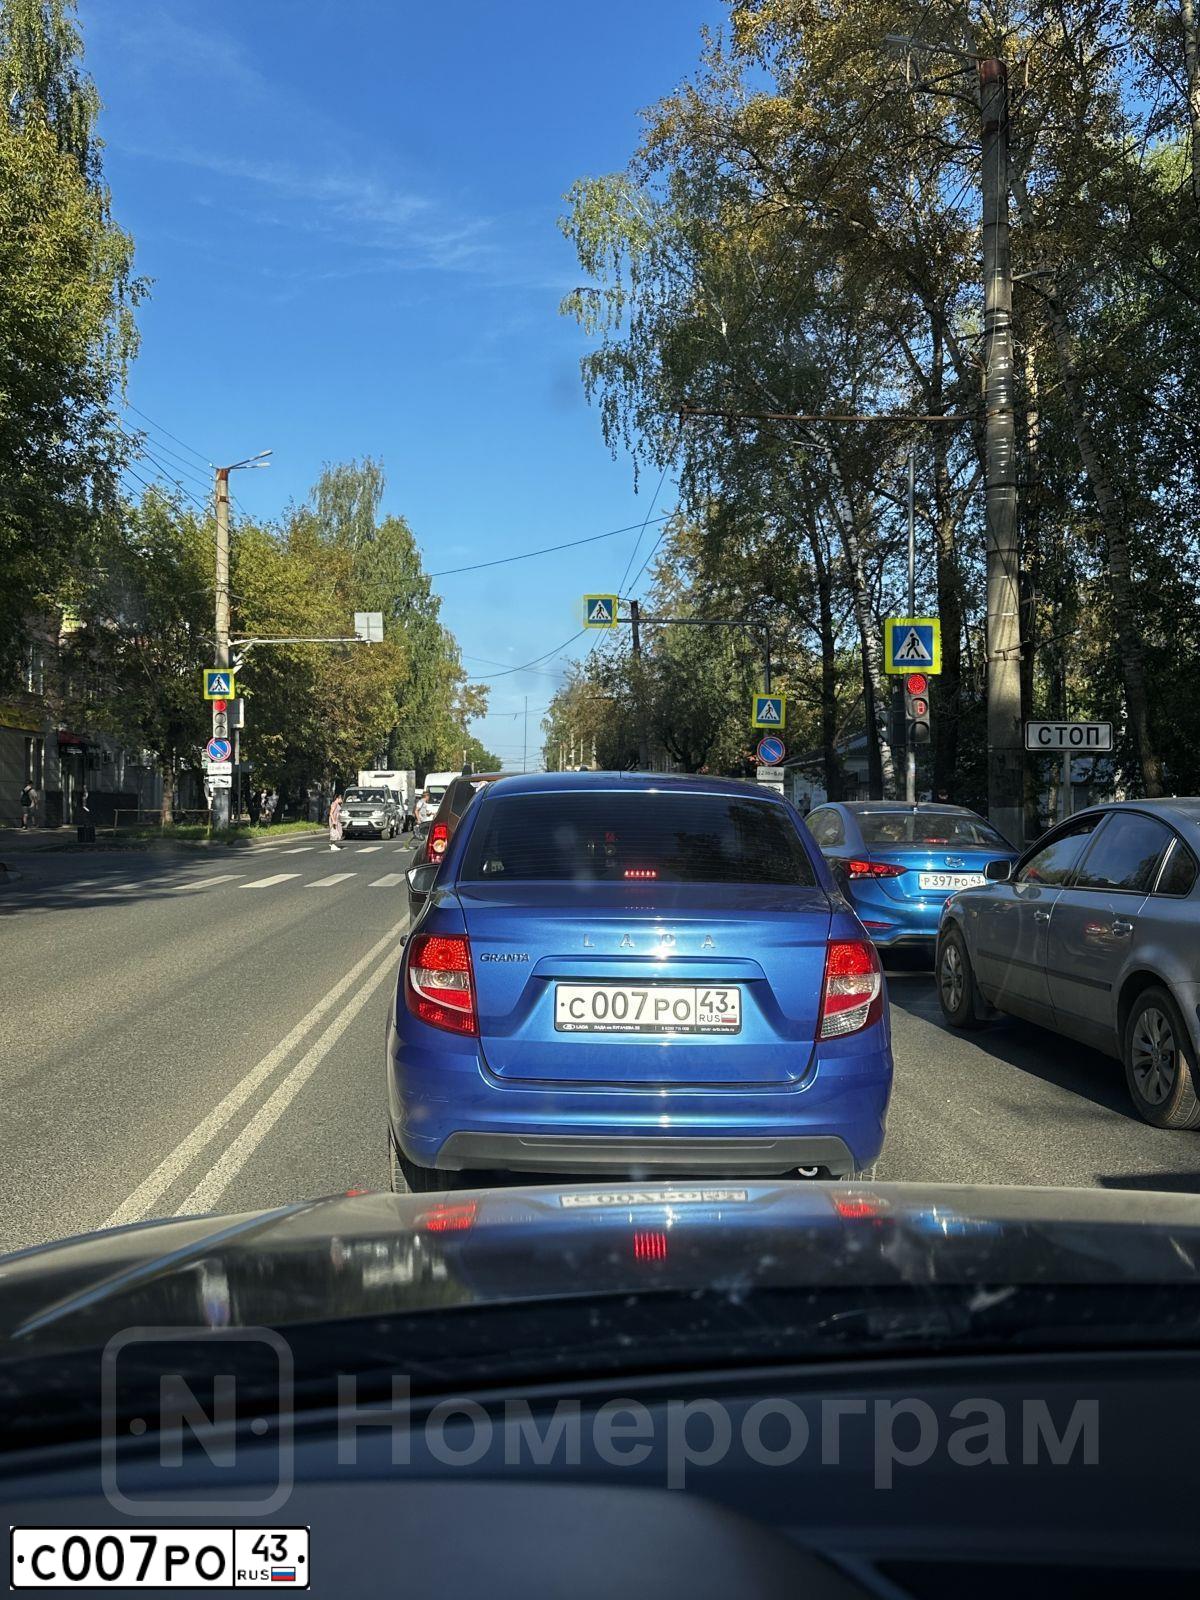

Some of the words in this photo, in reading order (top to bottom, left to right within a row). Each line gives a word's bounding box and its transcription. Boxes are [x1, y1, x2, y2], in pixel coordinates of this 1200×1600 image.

[1038, 726, 1100, 746] СТОП
[923, 875, 968, 887] Р397РО
[970, 877, 981, 885] 43
[583, 933, 716, 949] LADA
[480, 952, 530, 964] GRANTA
[569, 990, 691, 1021] С007РО
[699, 991, 729, 1013] 43
[699, 1014, 721, 1023] RUS
